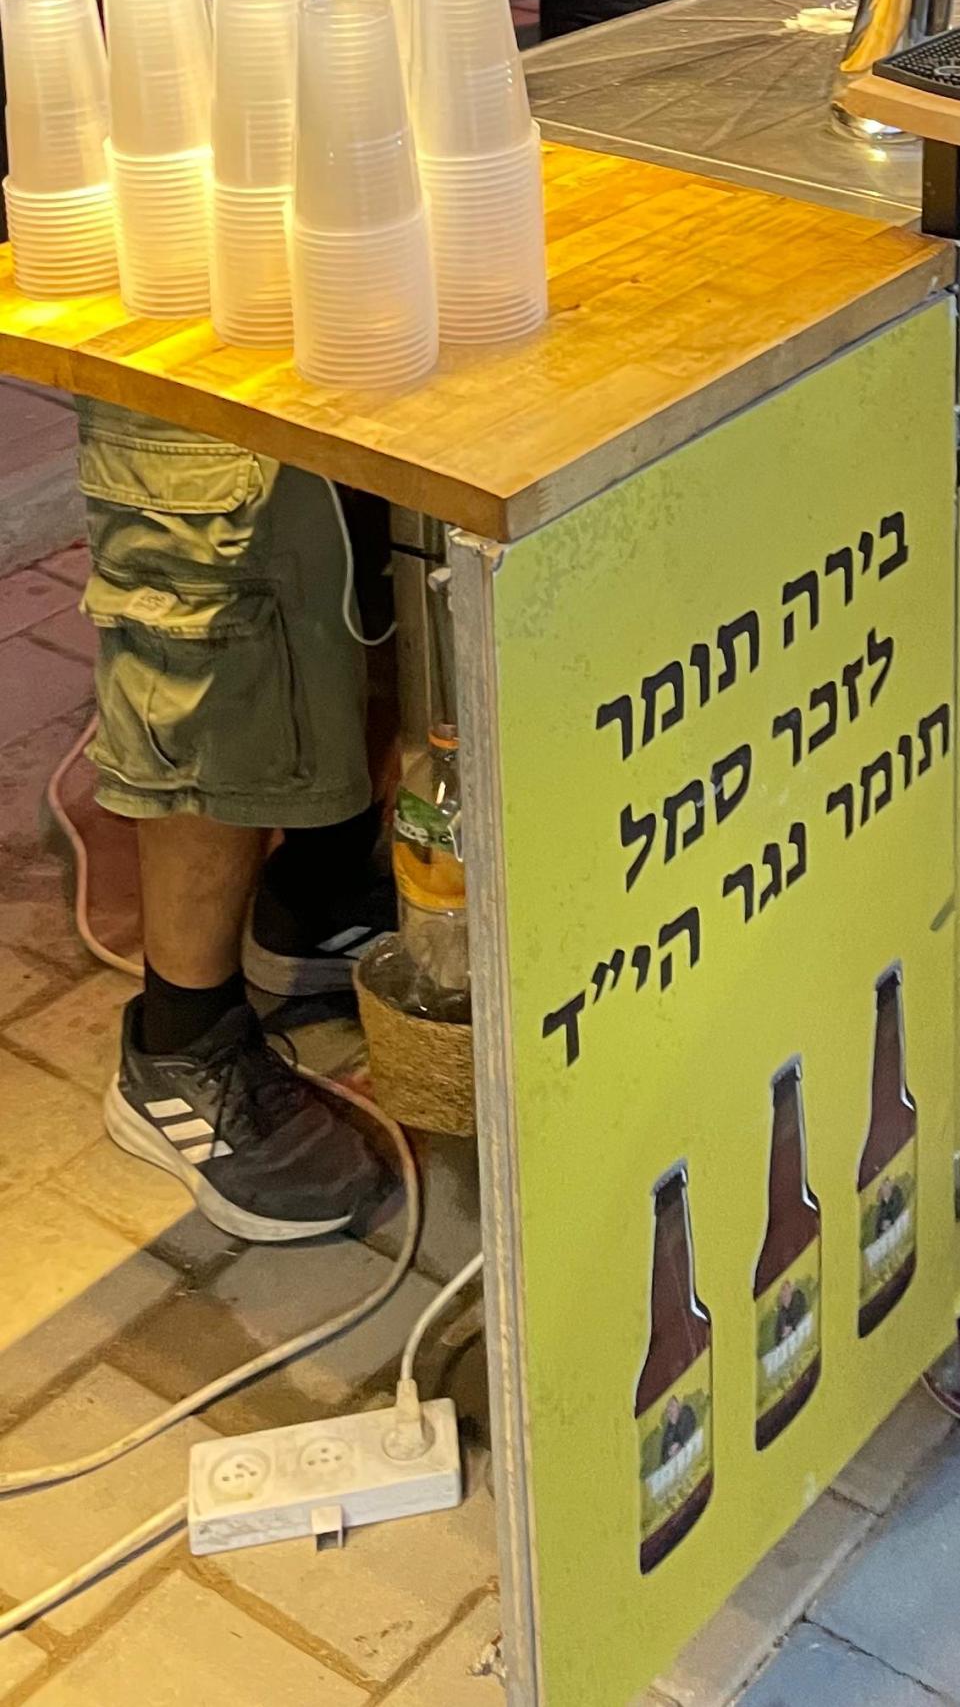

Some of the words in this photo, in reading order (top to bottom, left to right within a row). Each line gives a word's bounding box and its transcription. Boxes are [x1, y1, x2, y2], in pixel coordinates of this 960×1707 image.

[782, 511, 908, 650] בירה
[596, 610, 760, 761] תומר
[772, 627, 894, 767] לזכר
[620, 743, 752, 892] סמל
[825, 703, 950, 839] תומר
[722, 822, 806, 924] נגר
